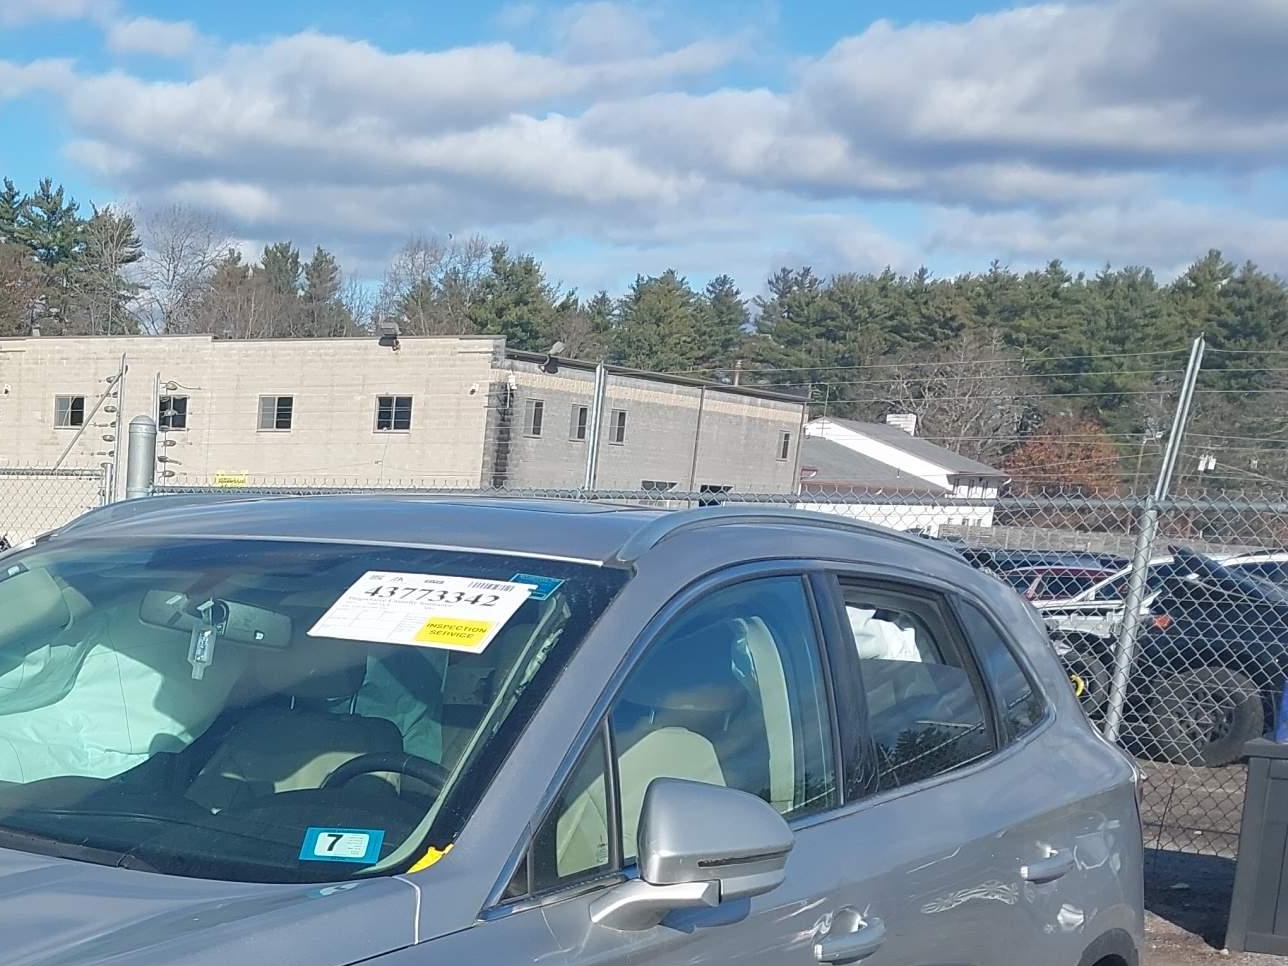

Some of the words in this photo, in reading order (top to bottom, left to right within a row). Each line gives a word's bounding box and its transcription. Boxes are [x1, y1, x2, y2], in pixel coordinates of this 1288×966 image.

[365, 585, 500, 607] 43773342
[426, 622, 488, 634] INSPECTION
[429, 629, 475, 639] SERVICE
[327, 833, 343, 851] 7
